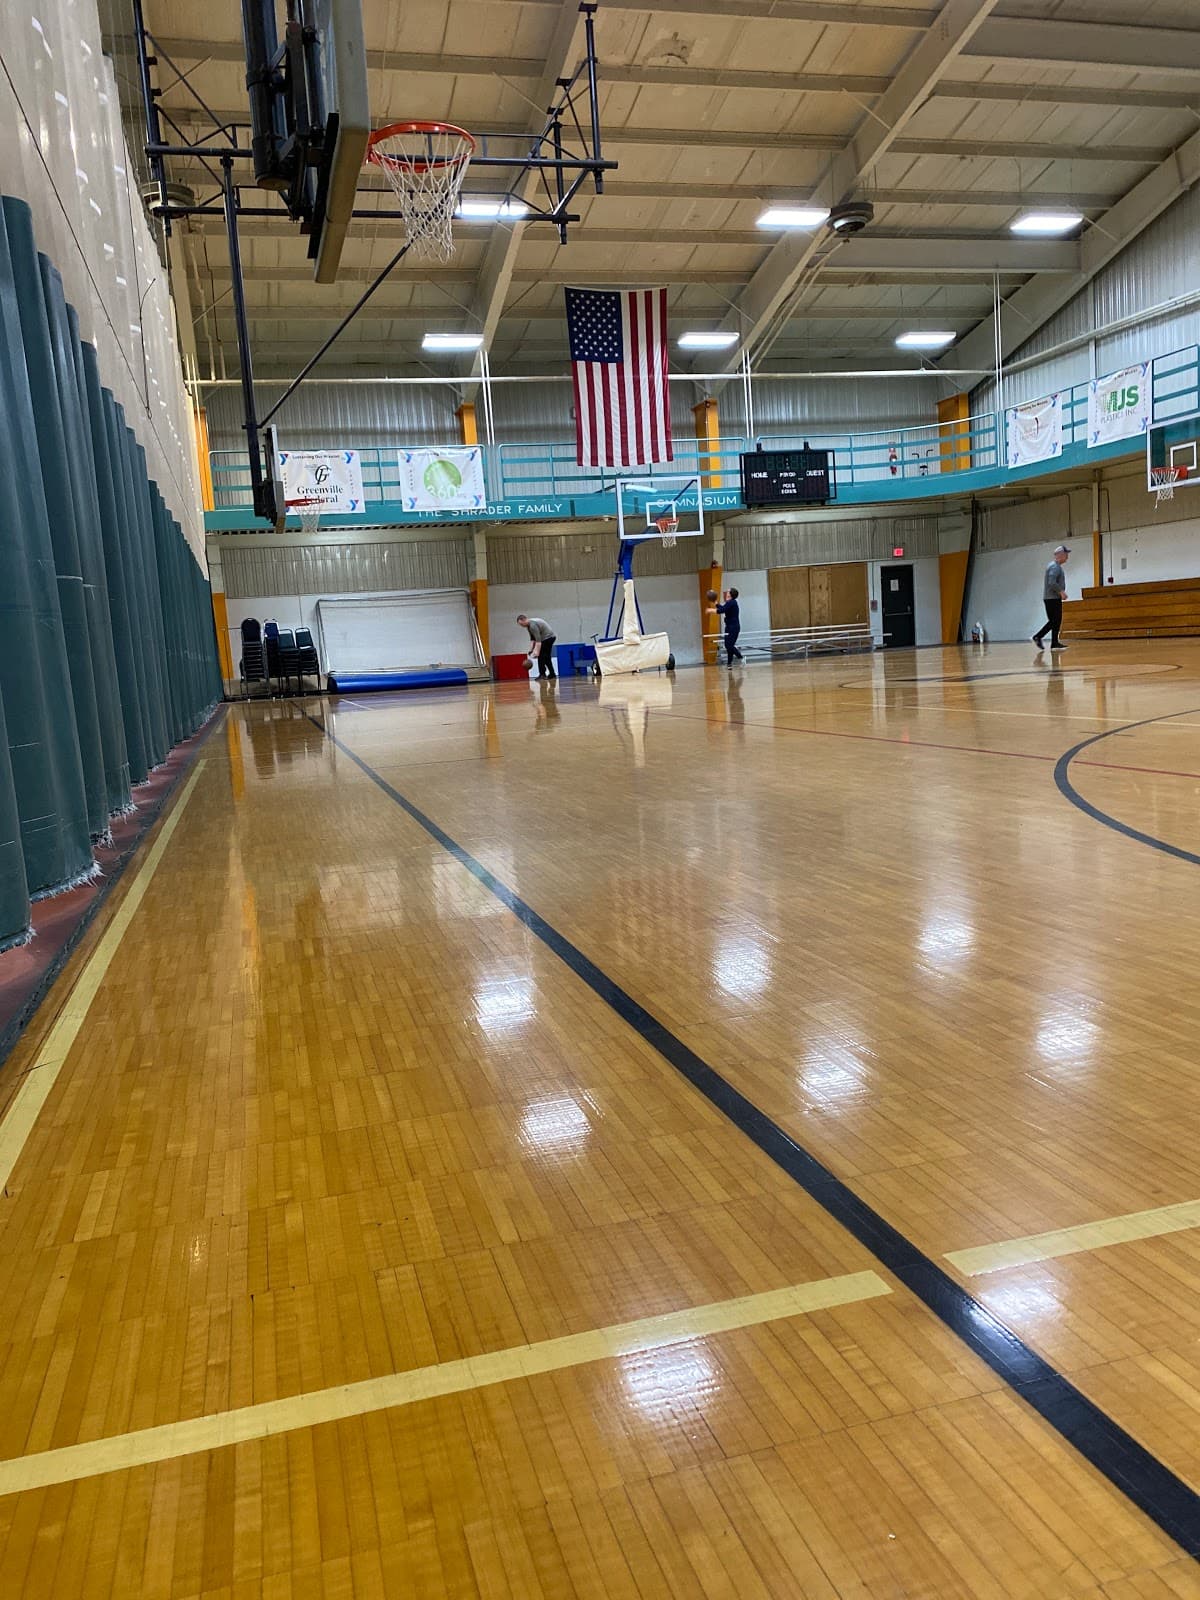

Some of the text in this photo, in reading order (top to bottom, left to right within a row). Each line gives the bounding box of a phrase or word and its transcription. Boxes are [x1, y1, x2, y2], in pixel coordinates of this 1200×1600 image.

[297, 485, 344, 495] Greenville
[452, 506, 511, 517] SHRADER
[518, 503, 562, 514] FAMILY
